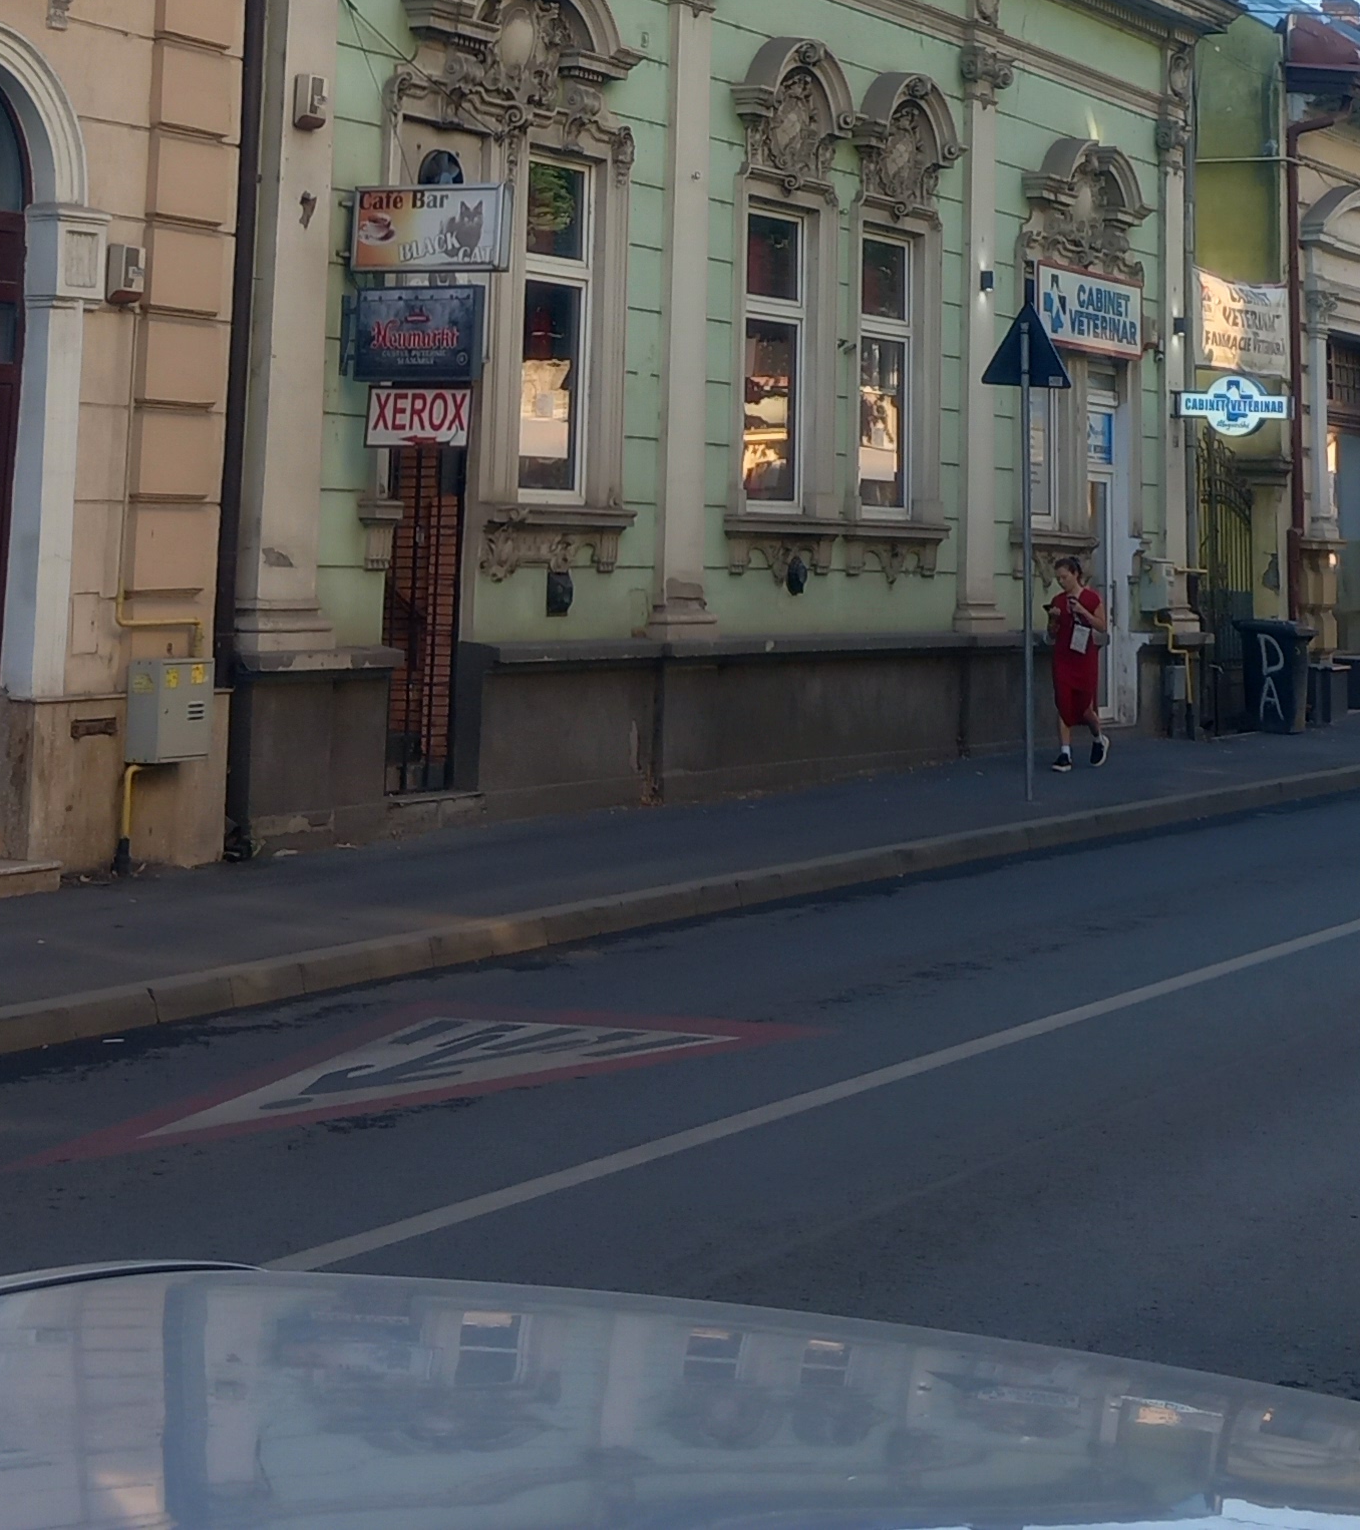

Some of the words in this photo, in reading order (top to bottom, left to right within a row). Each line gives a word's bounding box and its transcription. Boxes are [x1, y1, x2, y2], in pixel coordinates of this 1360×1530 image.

[411, 190, 449, 209] Bar
[398, 231, 460, 262] BLACK
[457, 245, 493, 263] CAT
[1077, 283, 1130, 318] CABINET
[1068, 308, 1138, 347] VETERINAR
[372, 392, 468, 432] XEROX
[1185, 398, 1226, 411] CABINET
[1230, 399, 1283, 413] VETERINAR
